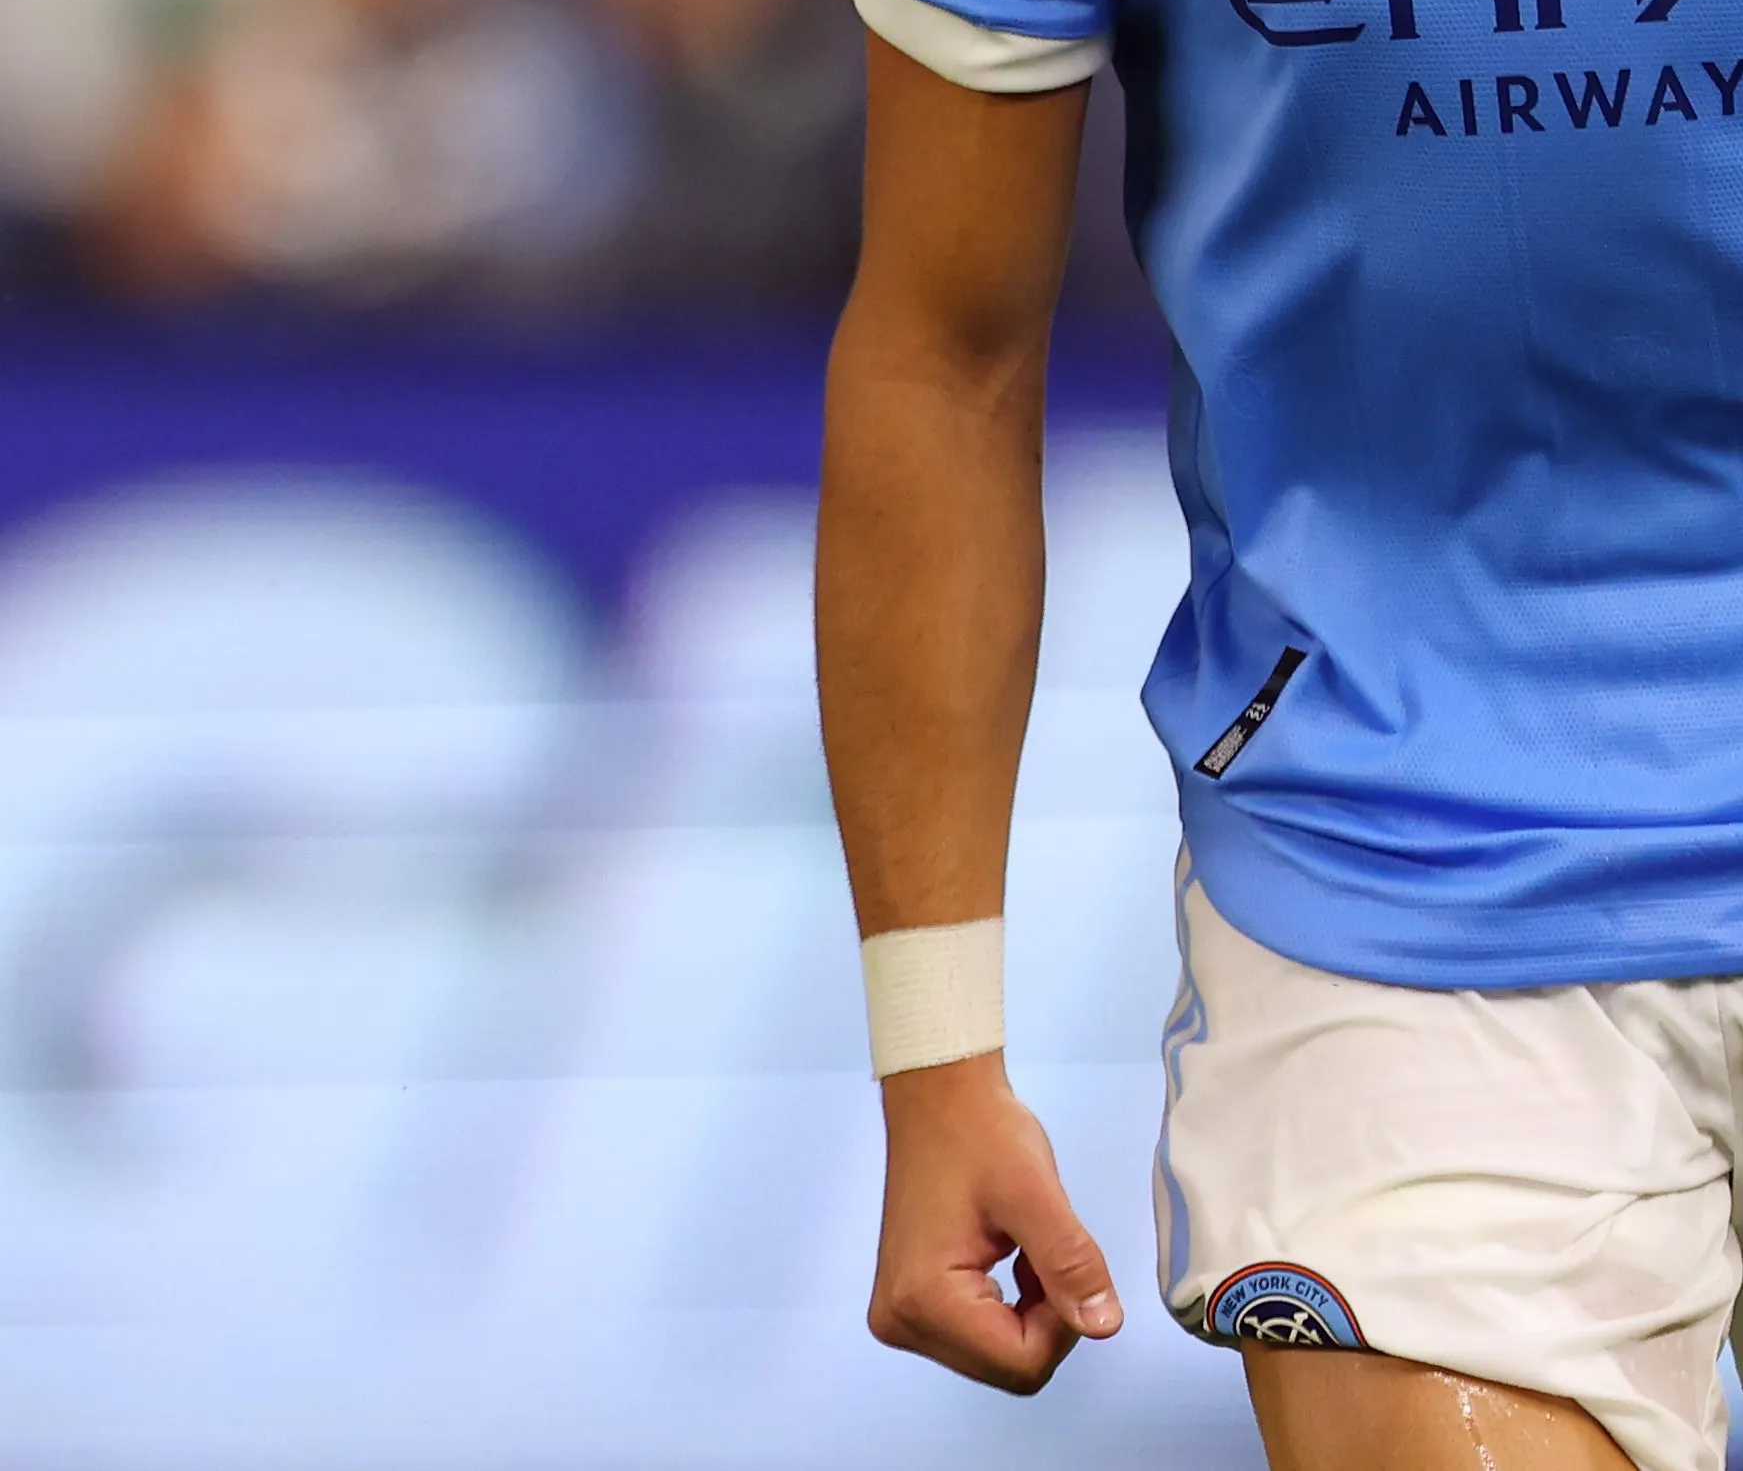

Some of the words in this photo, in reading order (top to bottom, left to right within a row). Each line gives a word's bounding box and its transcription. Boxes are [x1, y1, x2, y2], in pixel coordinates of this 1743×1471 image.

[1221, 1286, 1246, 1318] NEW
[1249, 1276, 1290, 1292] YORK
[1294, 1280, 1329, 1309] CITY
